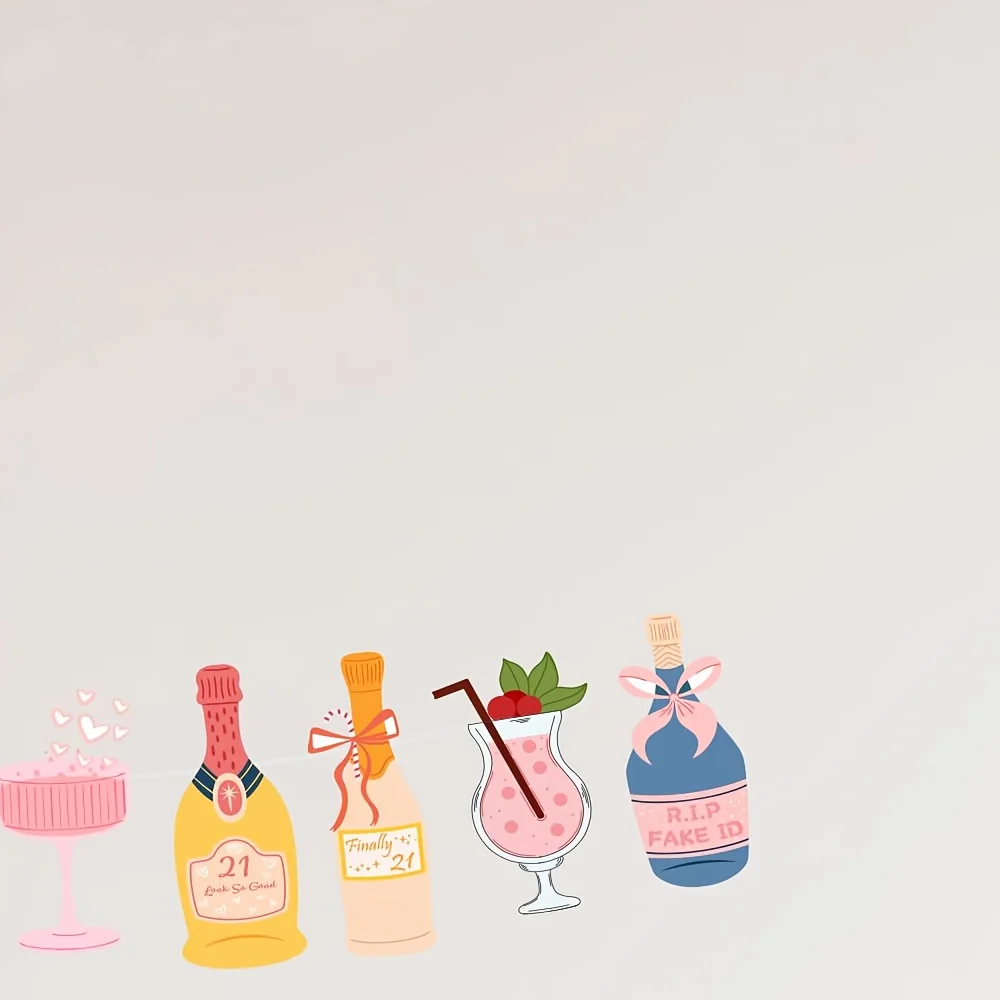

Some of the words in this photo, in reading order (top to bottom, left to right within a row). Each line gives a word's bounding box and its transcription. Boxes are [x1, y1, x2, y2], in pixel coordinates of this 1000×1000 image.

[666, 801, 720, 823] R.I.P
[647, 826, 711, 847] FAKE
[717, 820, 744, 840] ID
[345, 833, 393, 858] Finally
[218, 855, 249, 878] 21
[390, 851, 415, 872] 21
[203, 884, 230, 897] Look
[231, 883, 247, 894] So
[248, 880, 278, 891] Good
